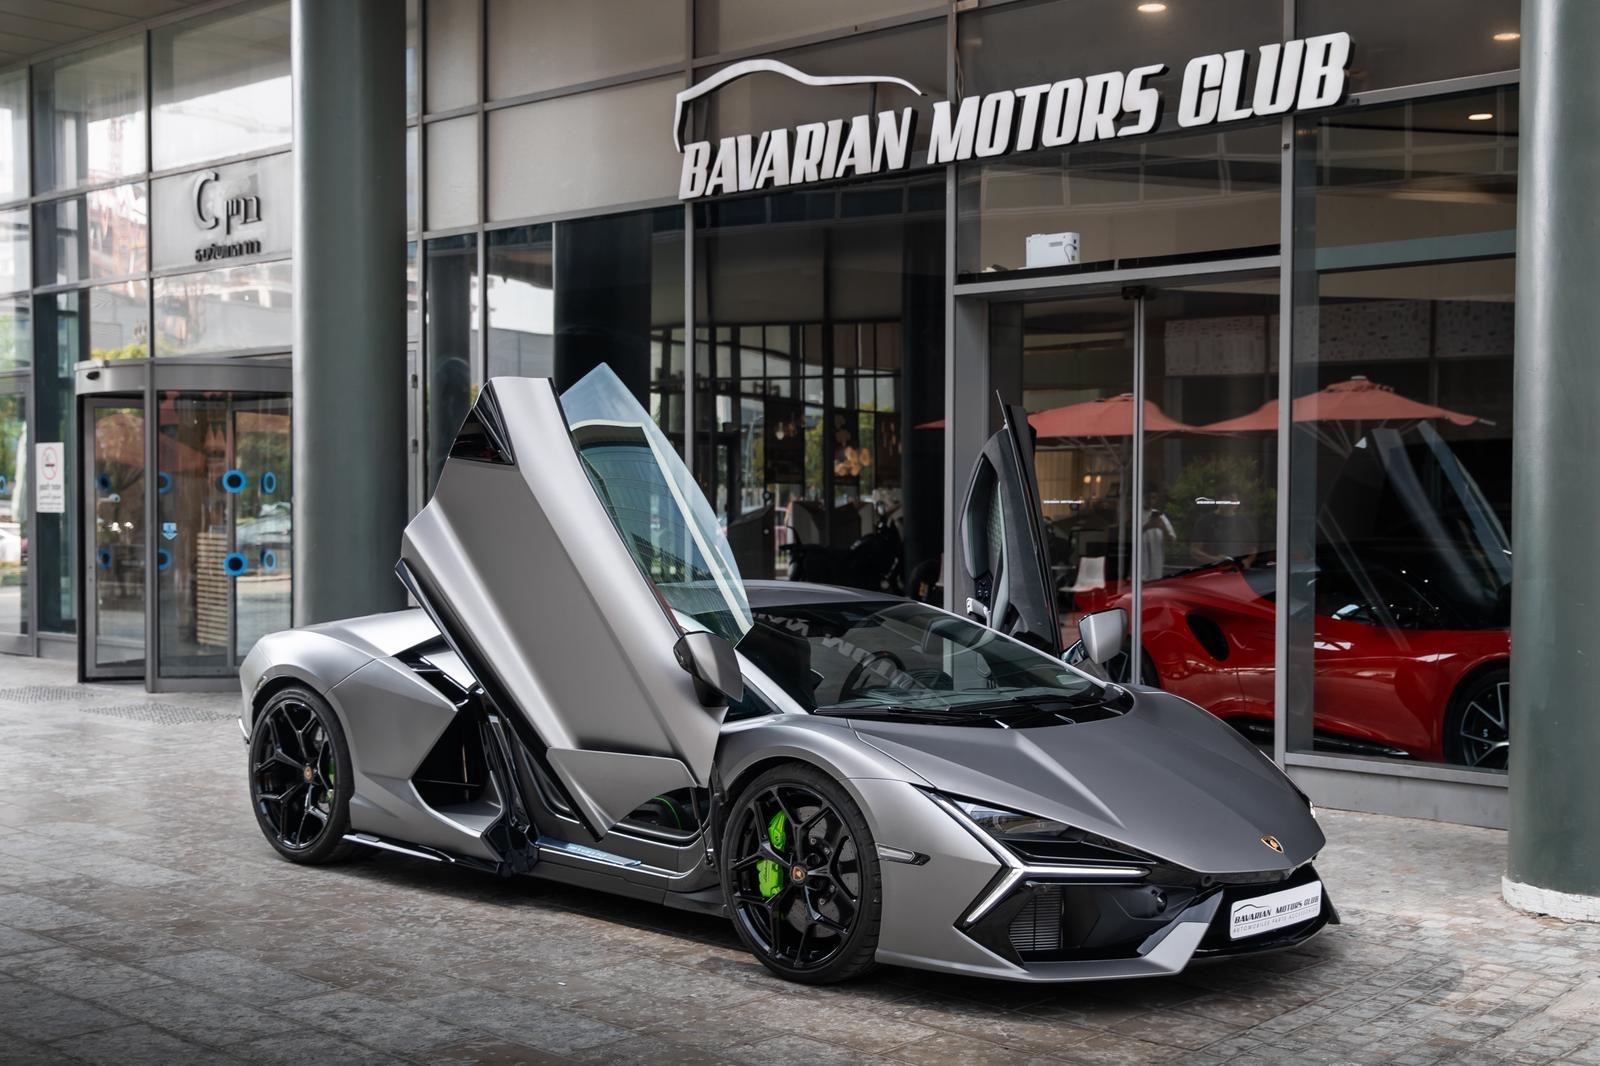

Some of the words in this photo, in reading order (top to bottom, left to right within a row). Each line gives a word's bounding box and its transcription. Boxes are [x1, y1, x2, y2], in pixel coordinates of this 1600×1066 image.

[678, 107, 914, 200] BAVARIAN
[927, 63, 1168, 164] MOTORS
[1178, 31, 1352, 128] CLUB
[1234, 909, 1272, 924] BAVARIAN
[1275, 901, 1303, 914] MOTORS
[1303, 895, 1319, 906] CLUB
